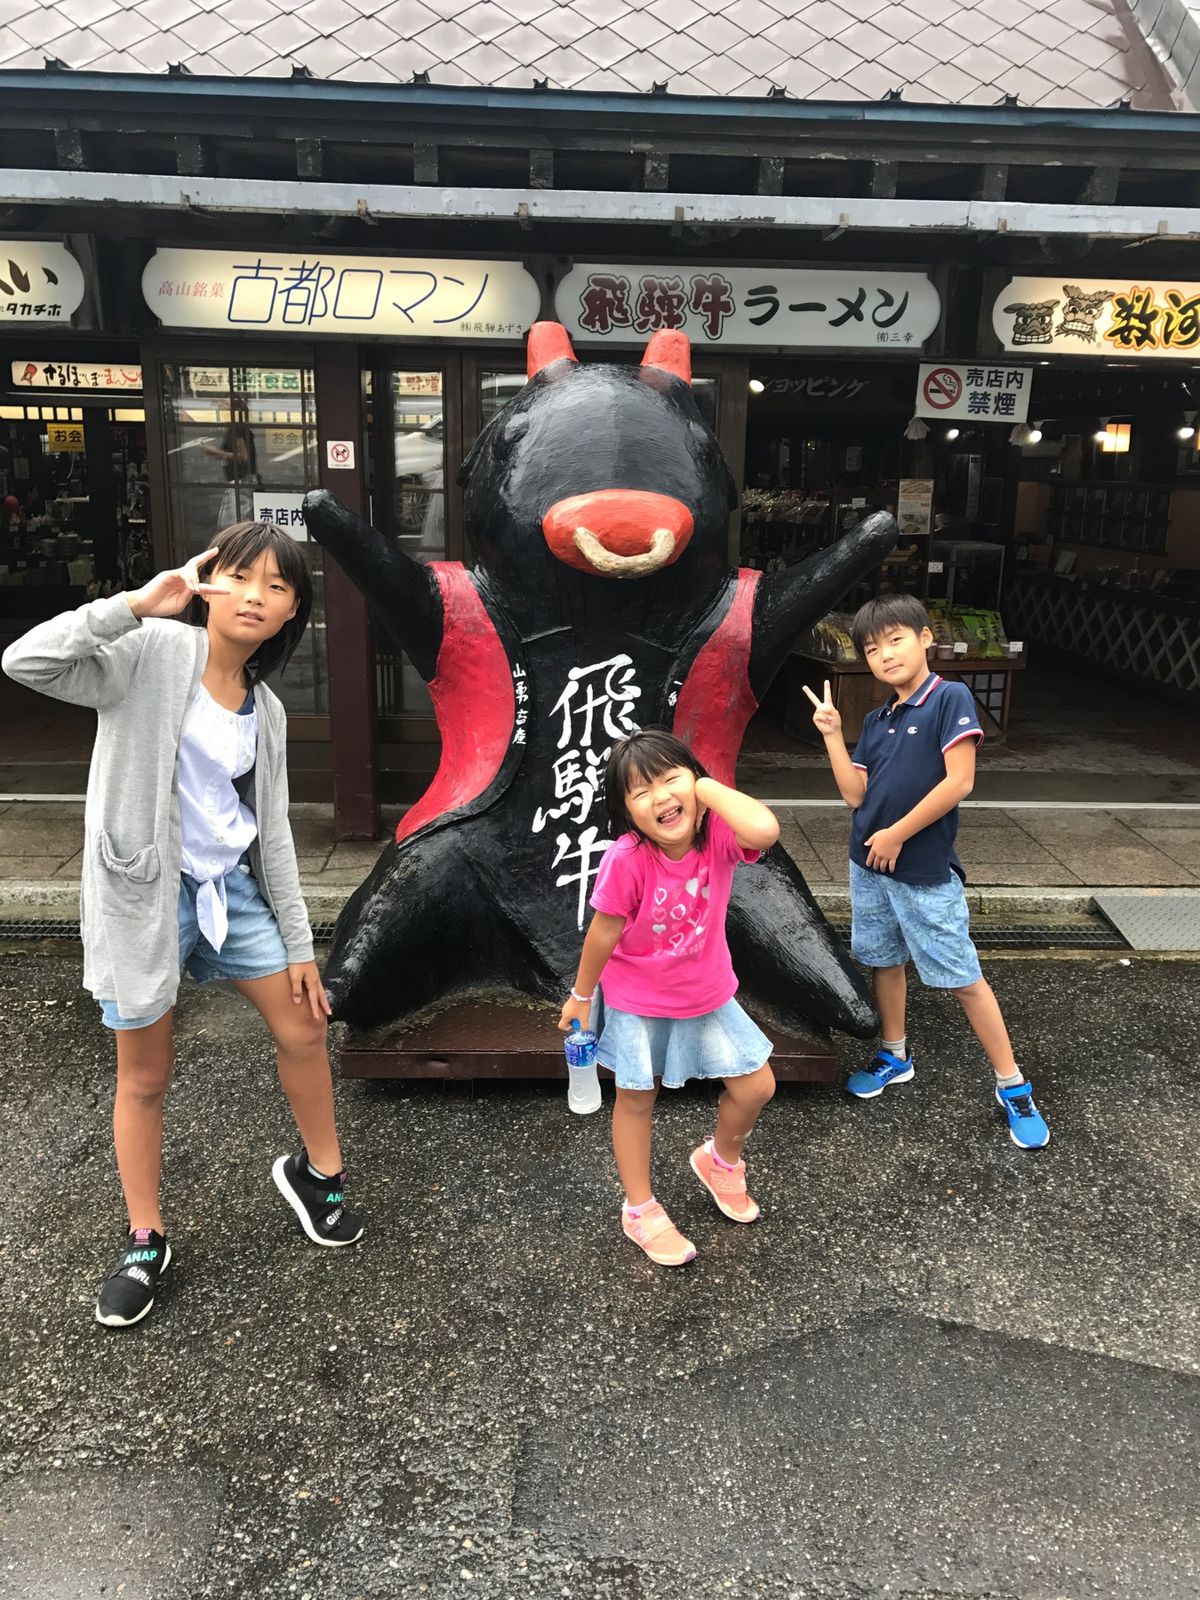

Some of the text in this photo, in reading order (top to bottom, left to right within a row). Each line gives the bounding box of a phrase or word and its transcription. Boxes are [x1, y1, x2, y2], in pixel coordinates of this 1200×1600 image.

[158, 258, 489, 325] 高山銘菓 古都ロマン
[966, 368, 1024, 389] 売店内
[968, 391, 1016, 416] 禁煙
[259, 508, 304, 526] 売店内
[124, 1250, 158, 1266] ANAP
[127, 1265, 151, 1286] GIRL
